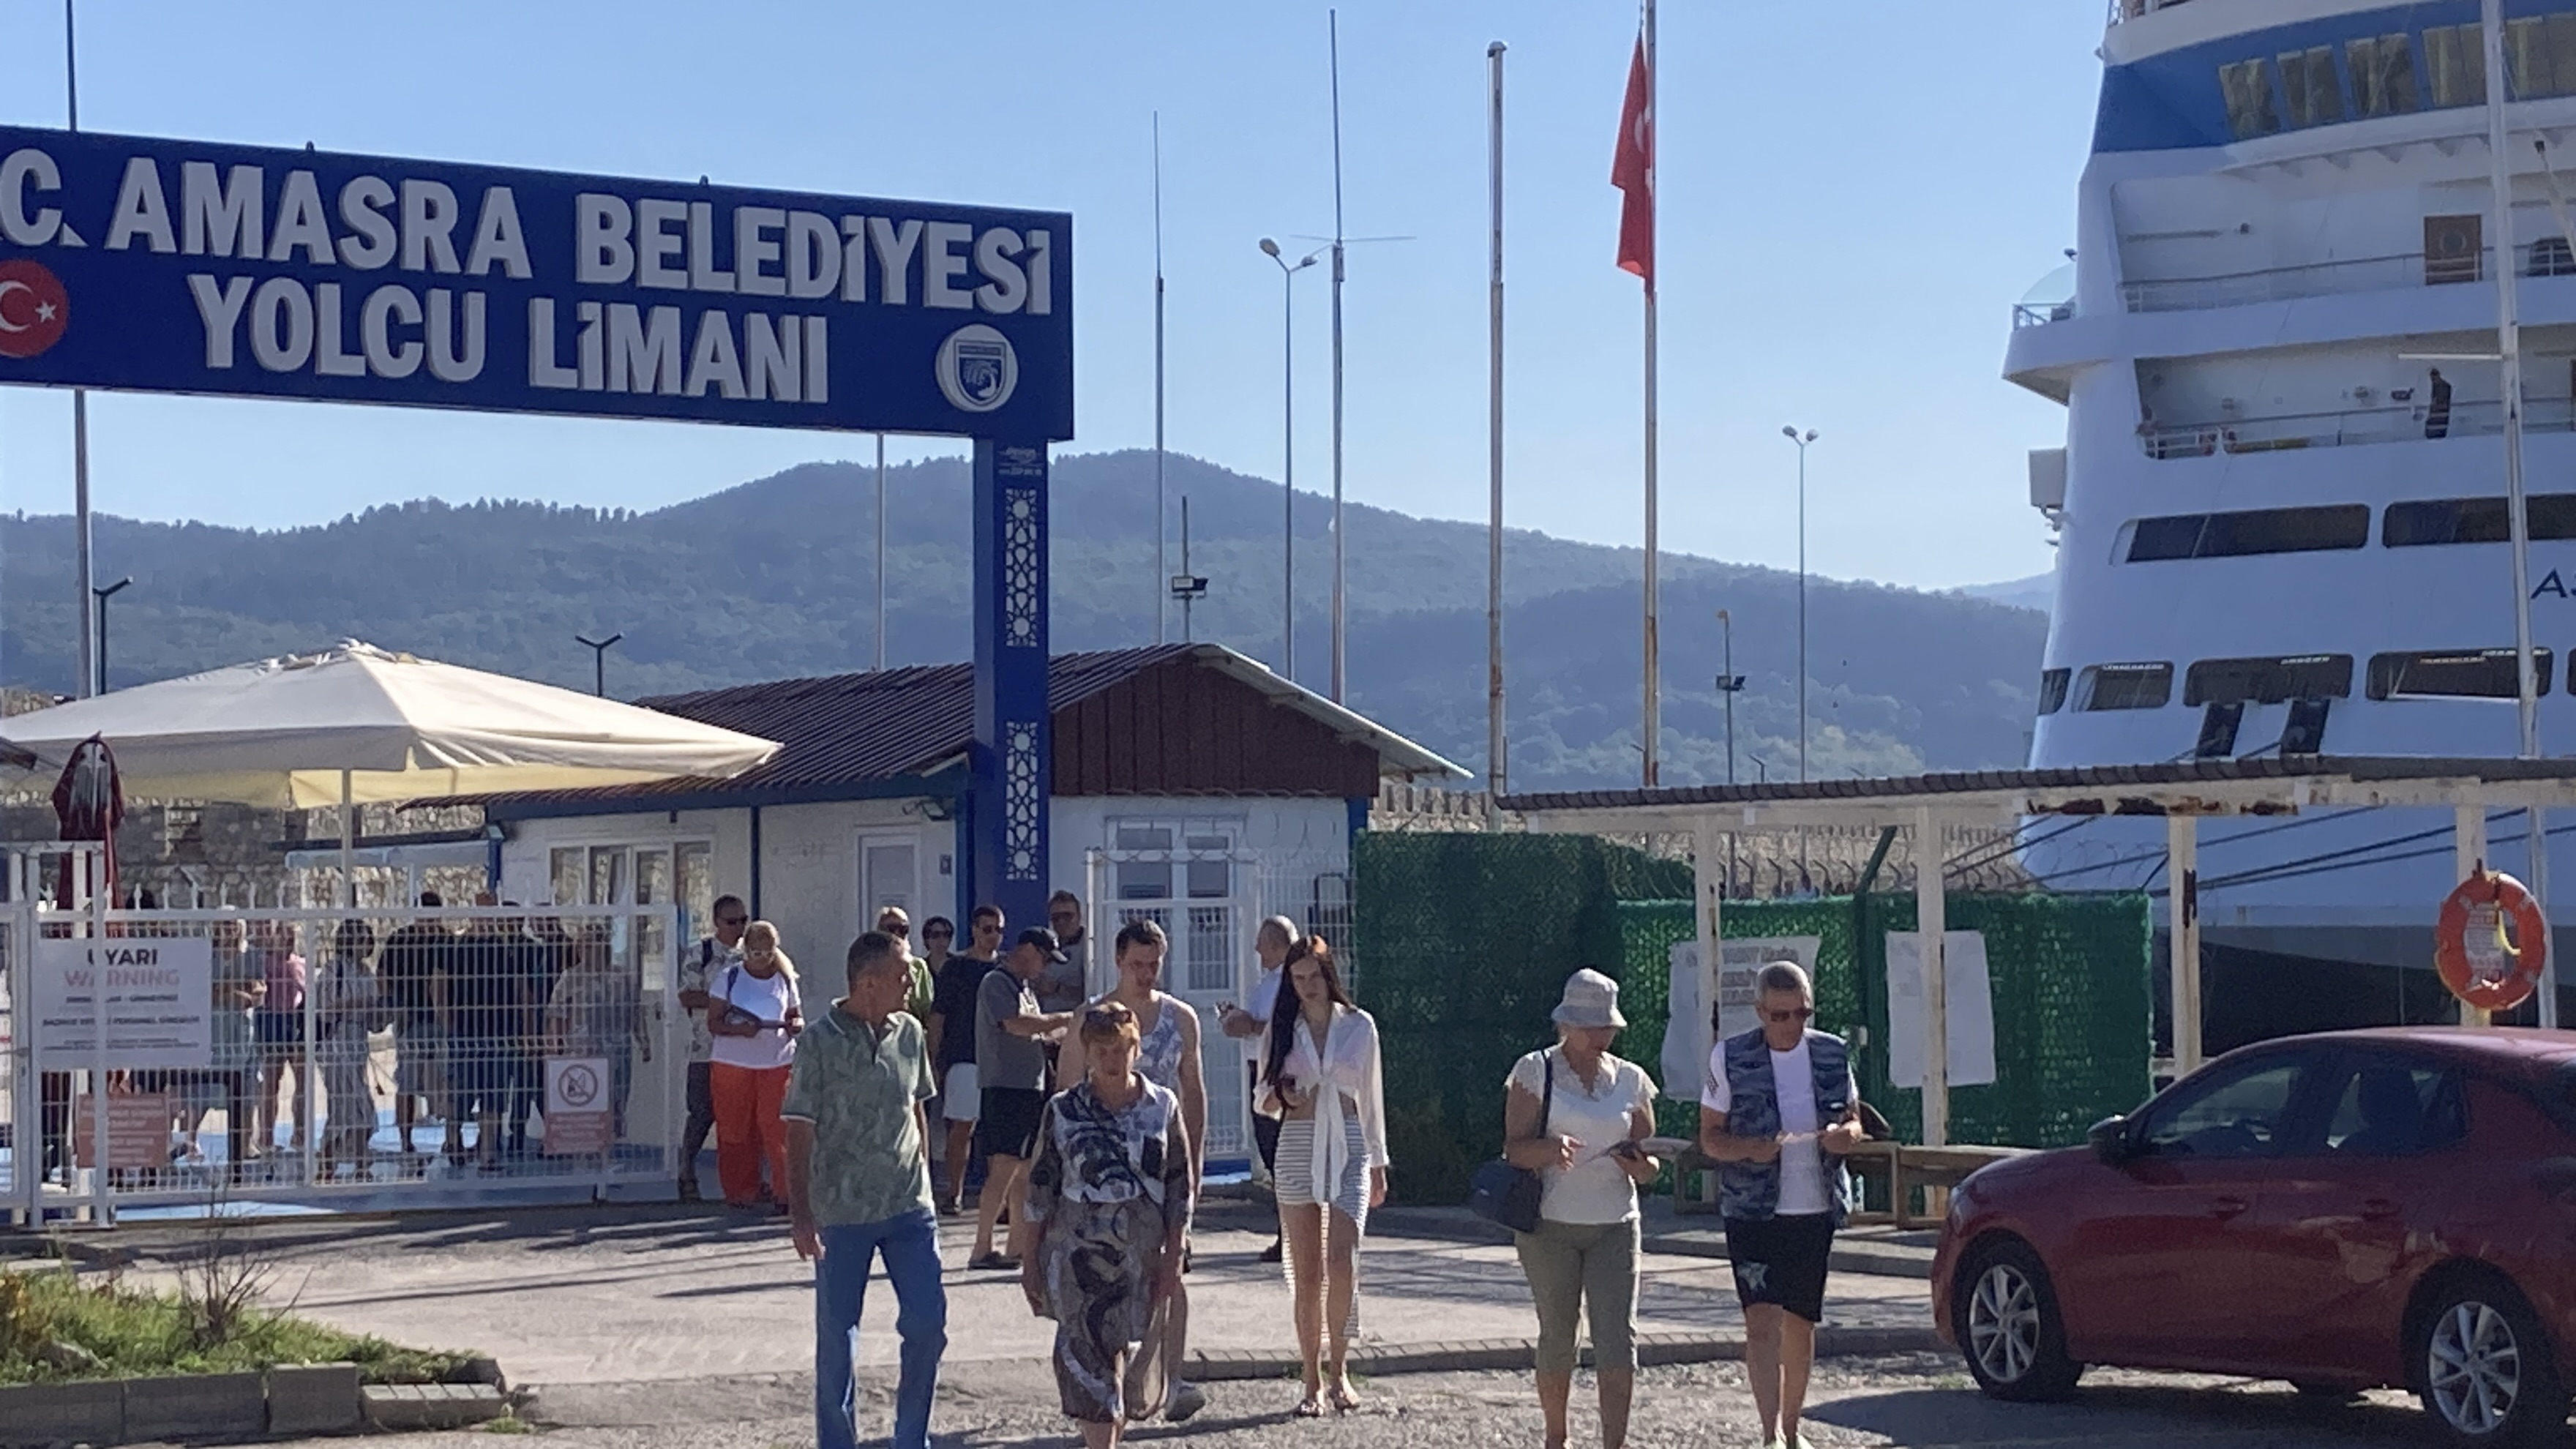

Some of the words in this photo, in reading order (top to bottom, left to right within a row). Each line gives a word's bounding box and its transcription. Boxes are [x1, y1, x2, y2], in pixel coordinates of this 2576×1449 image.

[103, 156, 534, 280] AMASRA
[187, 274, 487, 381] YOLCU
[528, 296, 829, 404] LİMANI
[64, 968, 180, 987] WRNING
